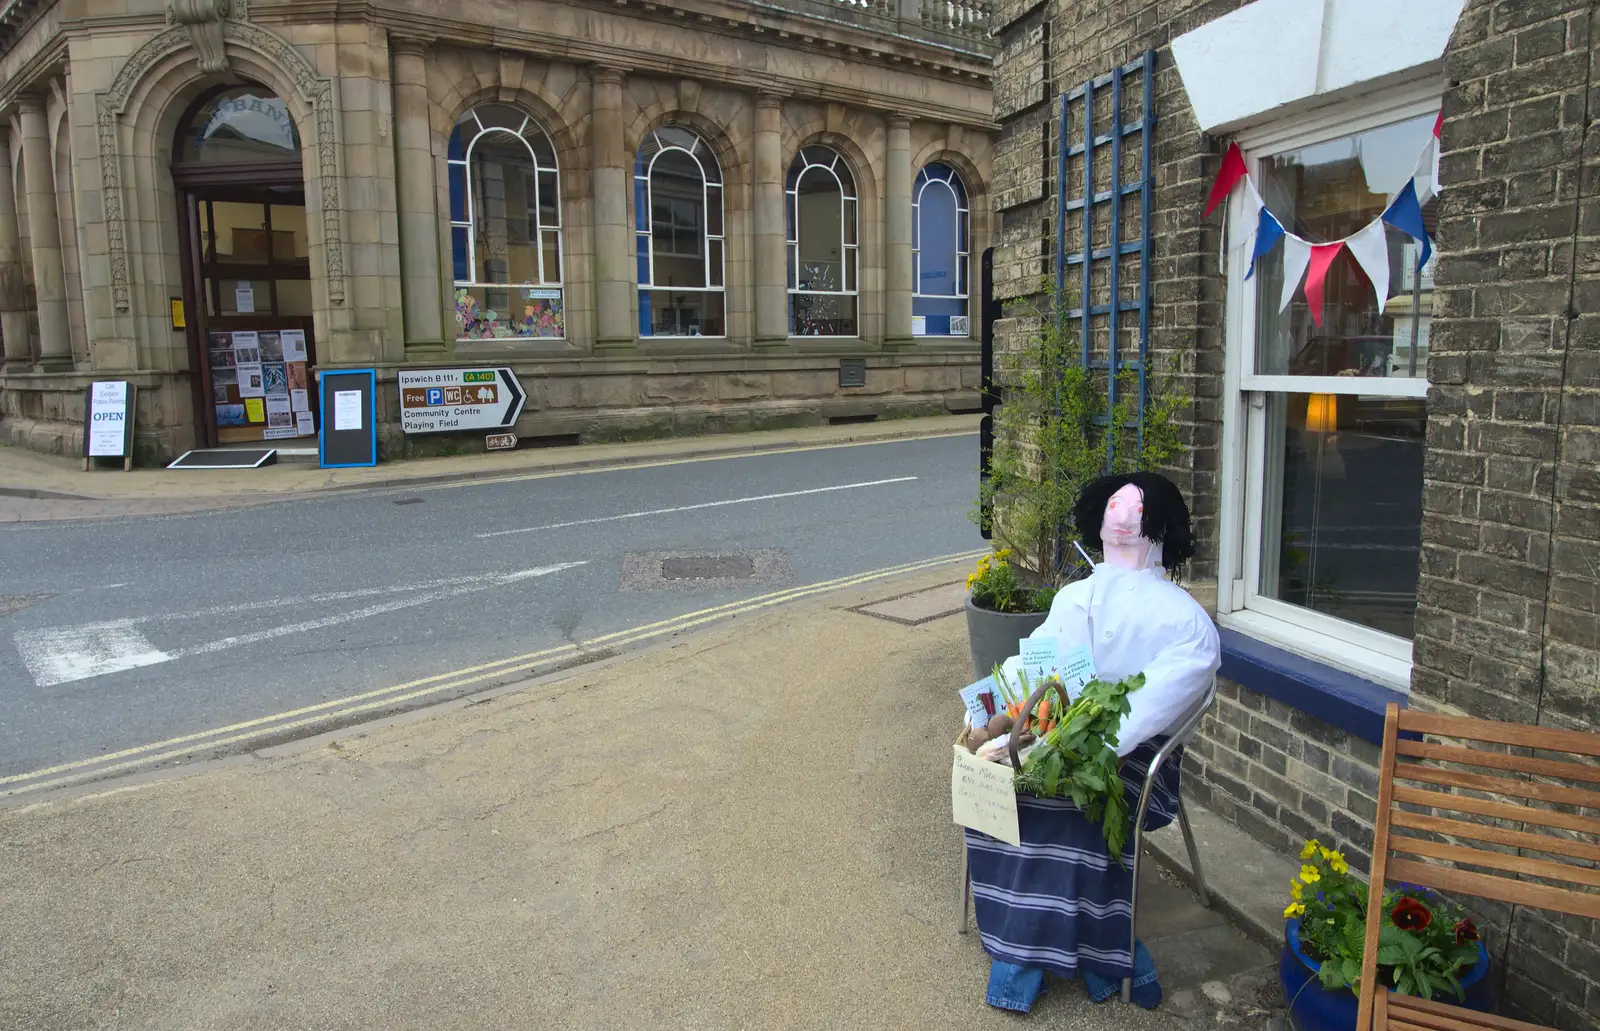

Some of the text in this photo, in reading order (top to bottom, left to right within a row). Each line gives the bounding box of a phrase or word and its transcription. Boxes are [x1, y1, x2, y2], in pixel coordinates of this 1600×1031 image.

[232, 99, 292, 143] BANK
[401, 374, 433, 384] Ipswich
[435, 374, 441, 382] B
[465, 372, 494, 381] (A 140)
[406, 390, 460, 404] Free P WC
[93, 412, 124, 421] OPEN
[404, 408, 481, 419] Community Centre
[404, 419, 459, 430] Playing Field
[1067, 659, 1086, 670] Journey
[1071, 662, 1091, 673] Country
